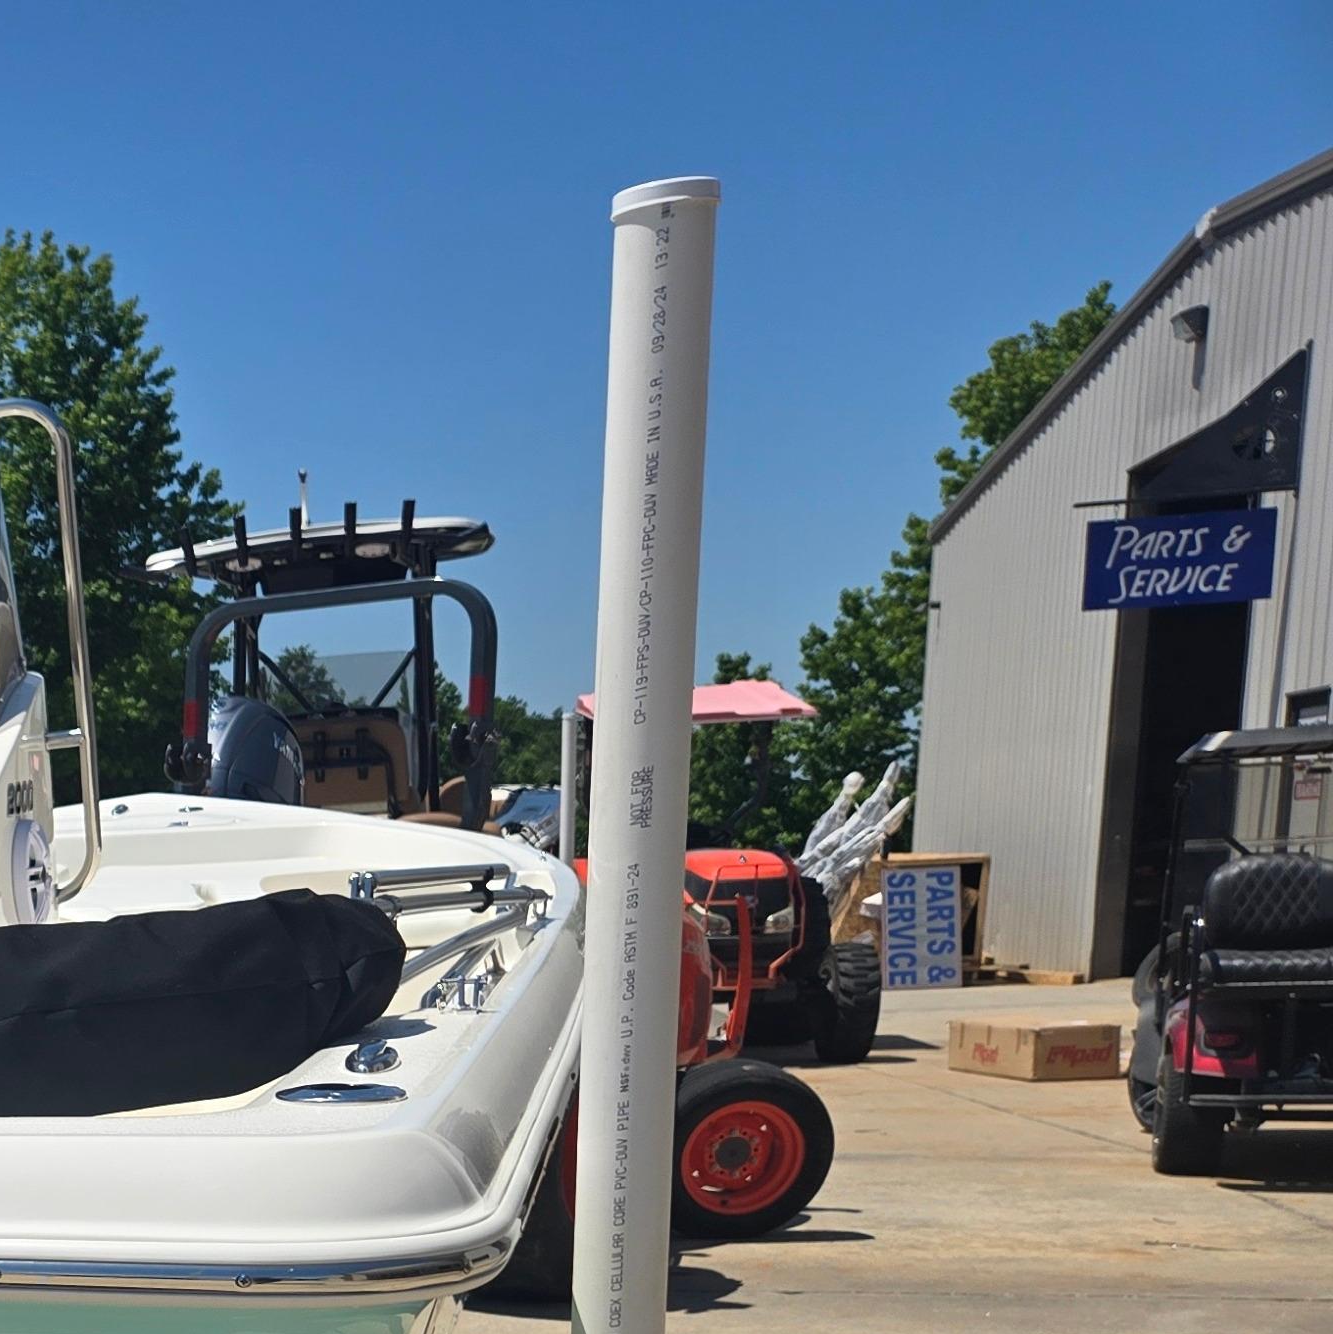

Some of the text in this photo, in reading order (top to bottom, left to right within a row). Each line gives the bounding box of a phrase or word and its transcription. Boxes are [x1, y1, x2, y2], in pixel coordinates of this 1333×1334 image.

[654, 226, 670, 270] 13:22
[650, 285, 667, 354] 09/28/24
[648, 369, 663, 421] U.S.A.
[646, 426, 660, 444] IN
[644, 451, 659, 485] MADE
[1105, 525, 1252, 569] PARTS &
[1108, 563, 1239, 604] SERVICE
[629, 770, 644, 826] NOT FOR
[640, 765, 654, 828] PRESSURE
[626, 863, 639, 910] 891-24
[625, 917, 637, 926] F
[886, 871, 918, 987] SERVICE
[926, 871, 956, 984] PARTS &
[624, 930, 638, 963] ASTM
[622, 969, 635, 1001] Code
[620, 1007, 634, 1039] U.P.
[616, 1100, 630, 1131] PIPE
[613, 1196, 626, 1227] CORE
[610, 1233, 625, 1292] CELLULAR
[609, 1298, 622, 1328] COEX
